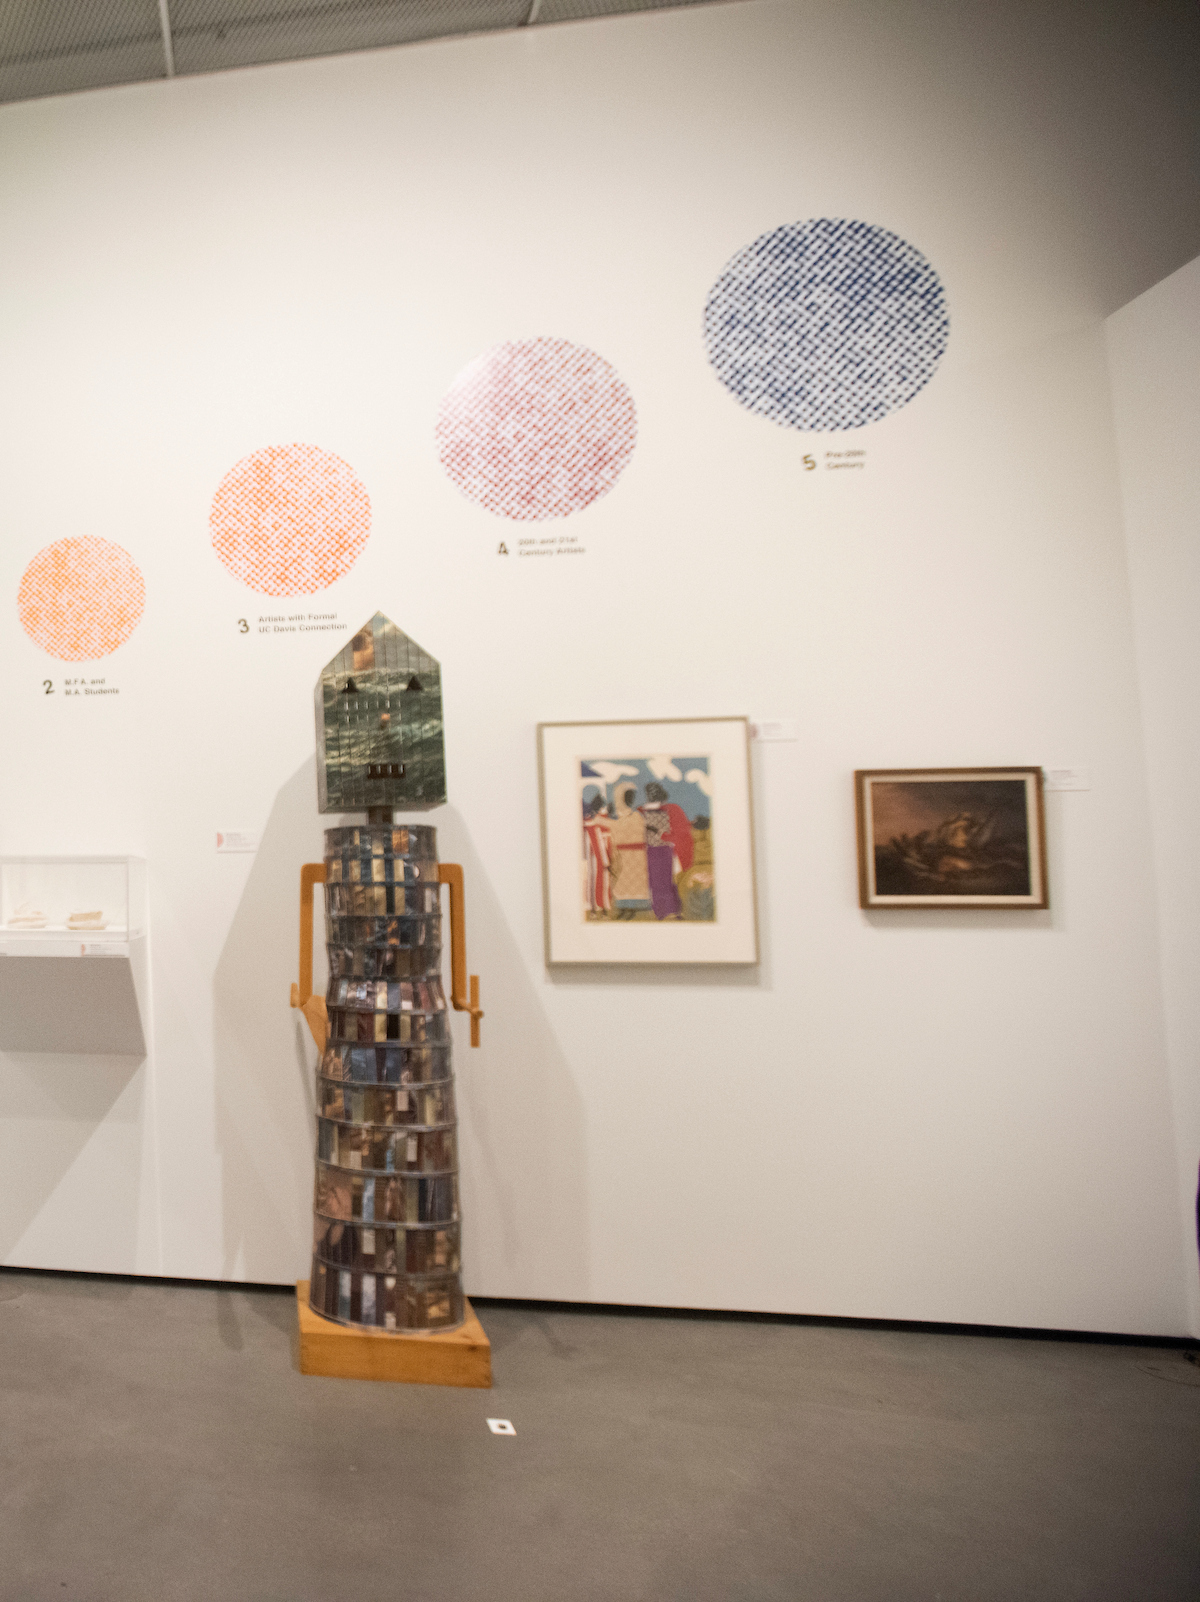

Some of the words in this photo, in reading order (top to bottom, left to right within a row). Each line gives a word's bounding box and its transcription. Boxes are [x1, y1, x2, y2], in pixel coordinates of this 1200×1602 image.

[802, 453, 817, 471] 5
[497, 541, 509, 555] 4
[258, 615, 286, 623] Artists
[288, 614, 306, 622] with
[308, 612, 338, 621] Formal
[237, 618, 251, 634] 3
[258, 625, 272, 633] UC
[273, 624, 297, 633] Davis
[299, 622, 348, 632] Connection
[42, 679, 56, 695] 2
[90, 677, 106, 685] and
[84, 687, 120, 696] Students
